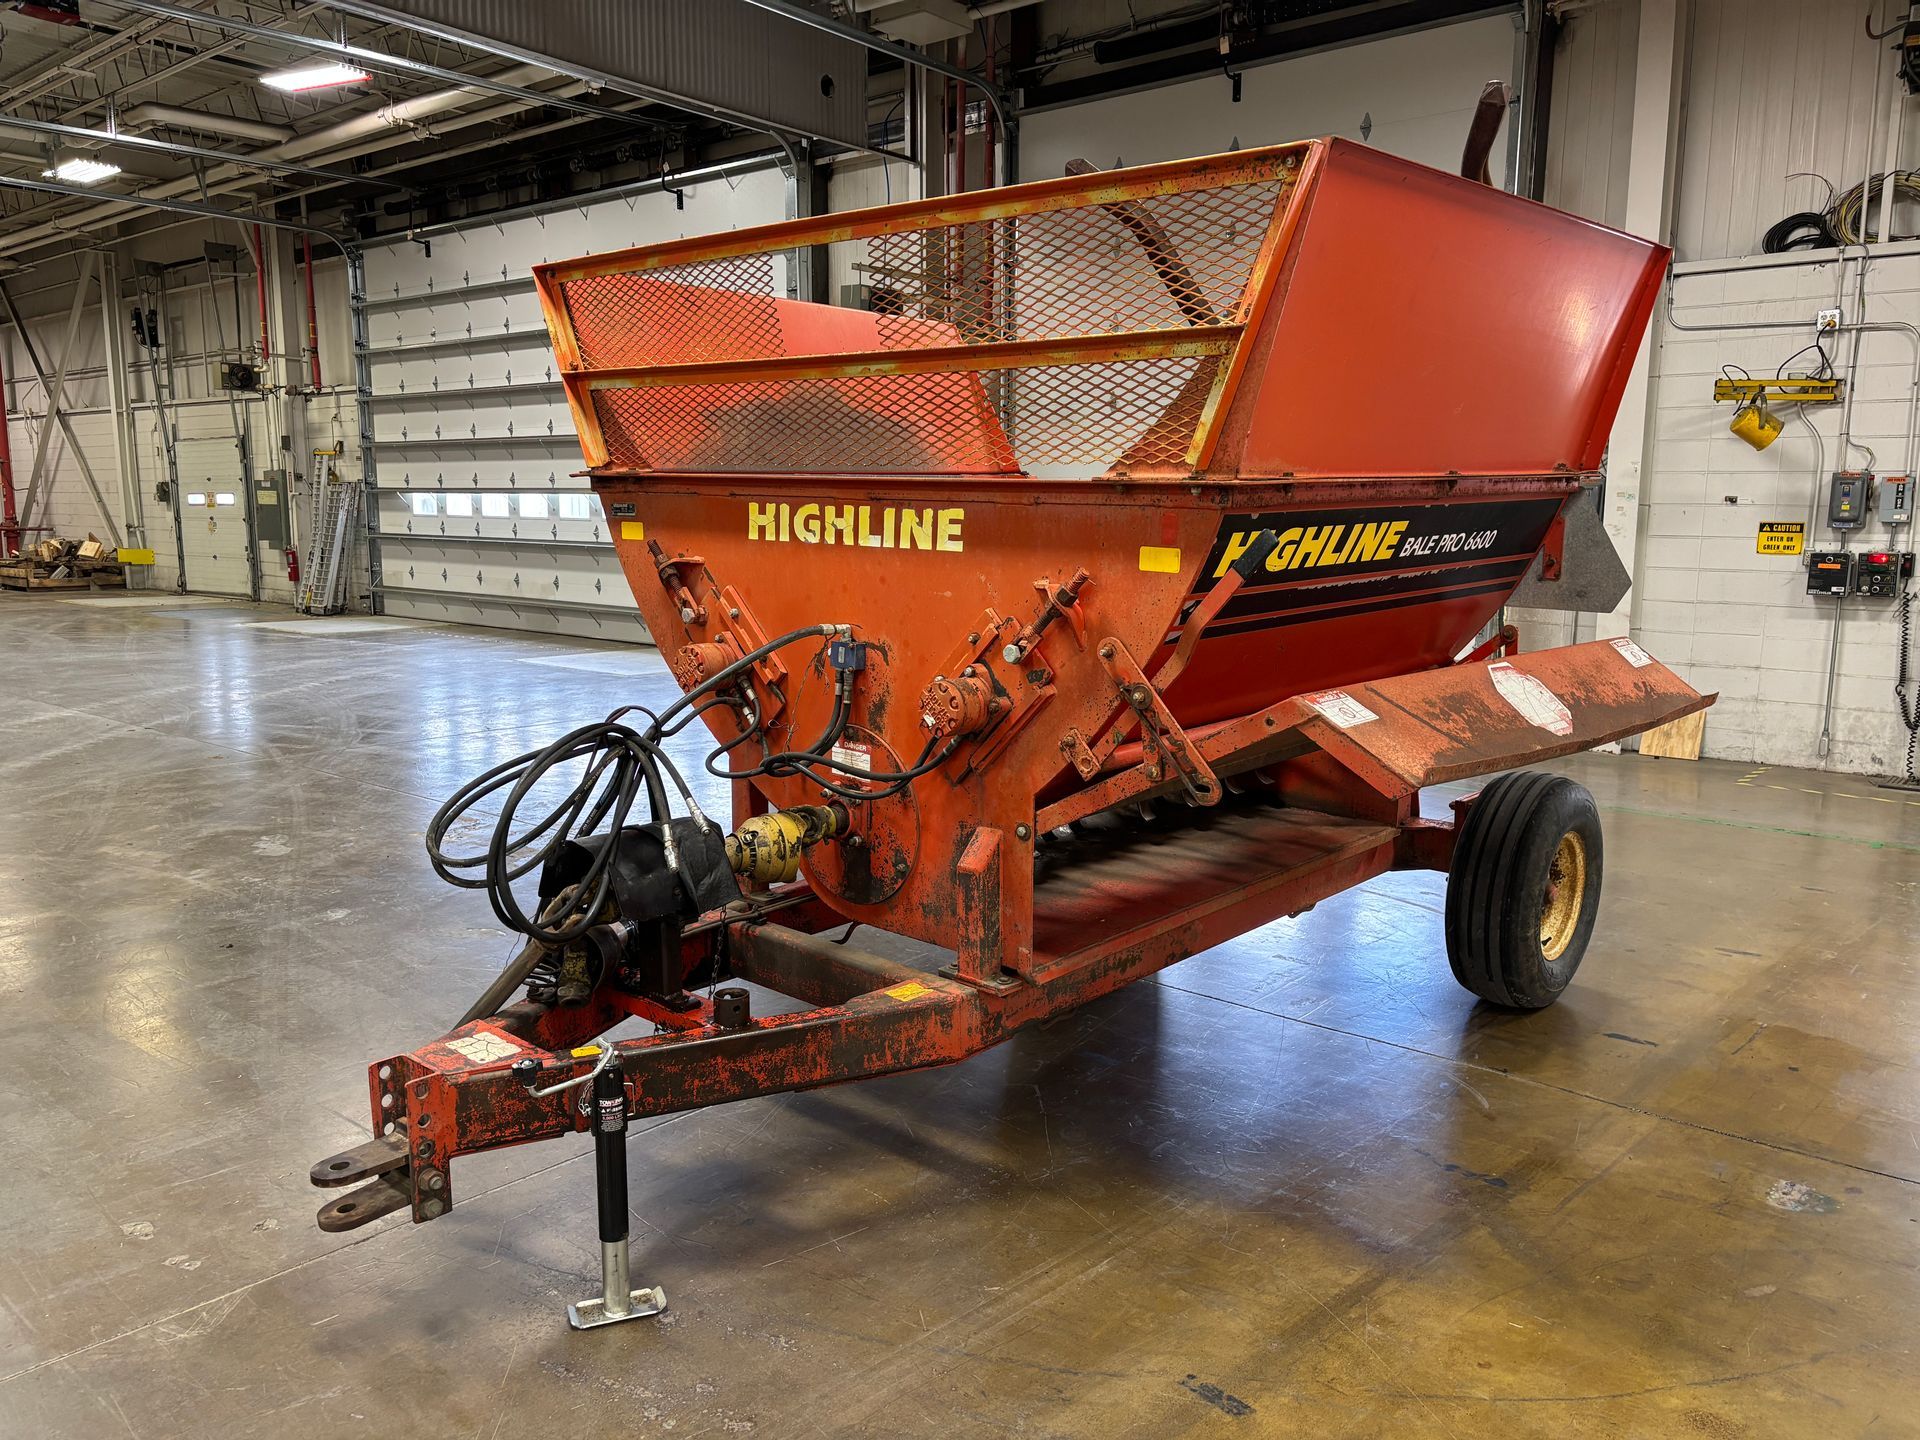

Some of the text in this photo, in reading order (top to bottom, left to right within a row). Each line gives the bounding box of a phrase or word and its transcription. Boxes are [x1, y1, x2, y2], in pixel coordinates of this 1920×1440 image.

[748, 502, 964, 552] HIGHLINE
[1773, 524, 1801, 532] CAUTION
[1212, 520, 1497, 578] HGHLINE BALE PRO 6600
[844, 741, 867, 752] DANGER
